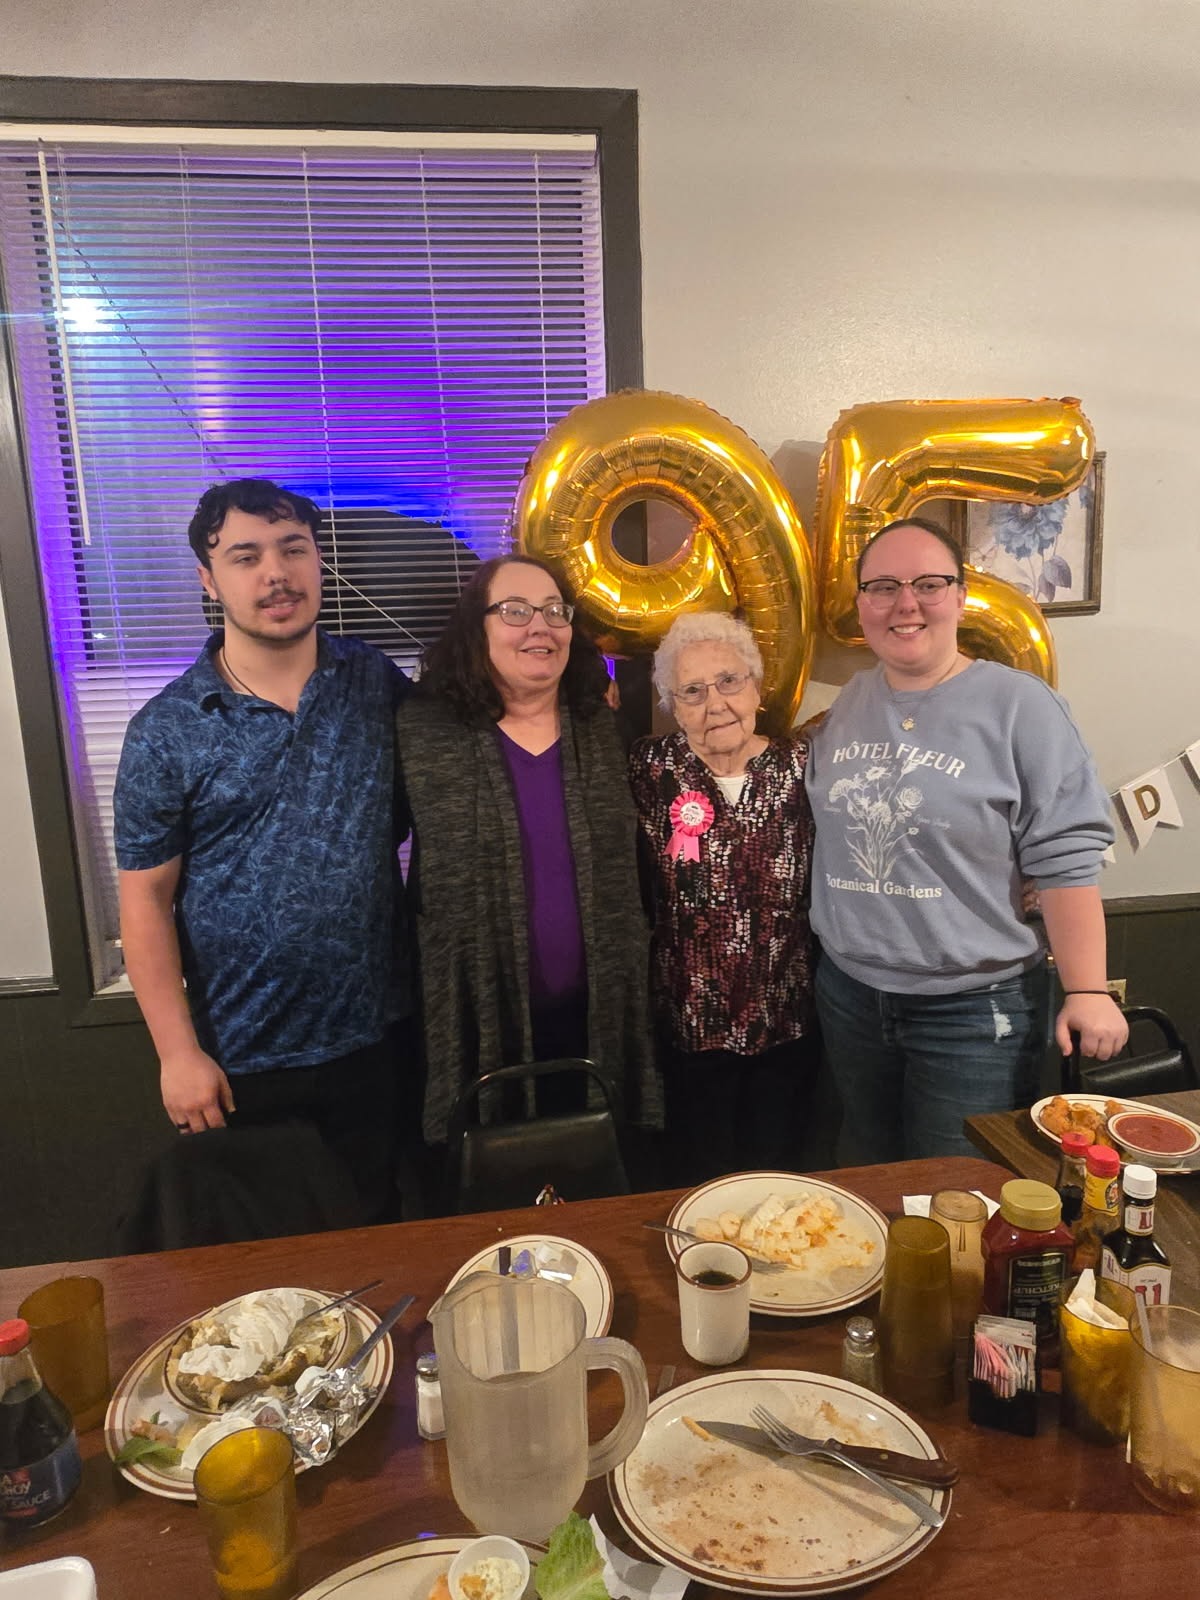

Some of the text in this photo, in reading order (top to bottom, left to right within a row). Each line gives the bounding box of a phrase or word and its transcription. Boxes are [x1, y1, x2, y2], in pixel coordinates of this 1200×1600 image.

[832, 741, 966, 778] HÔTEL FLEUR
[1133, 784, 1161, 821] D
[883, 882, 942, 898] Gardens
